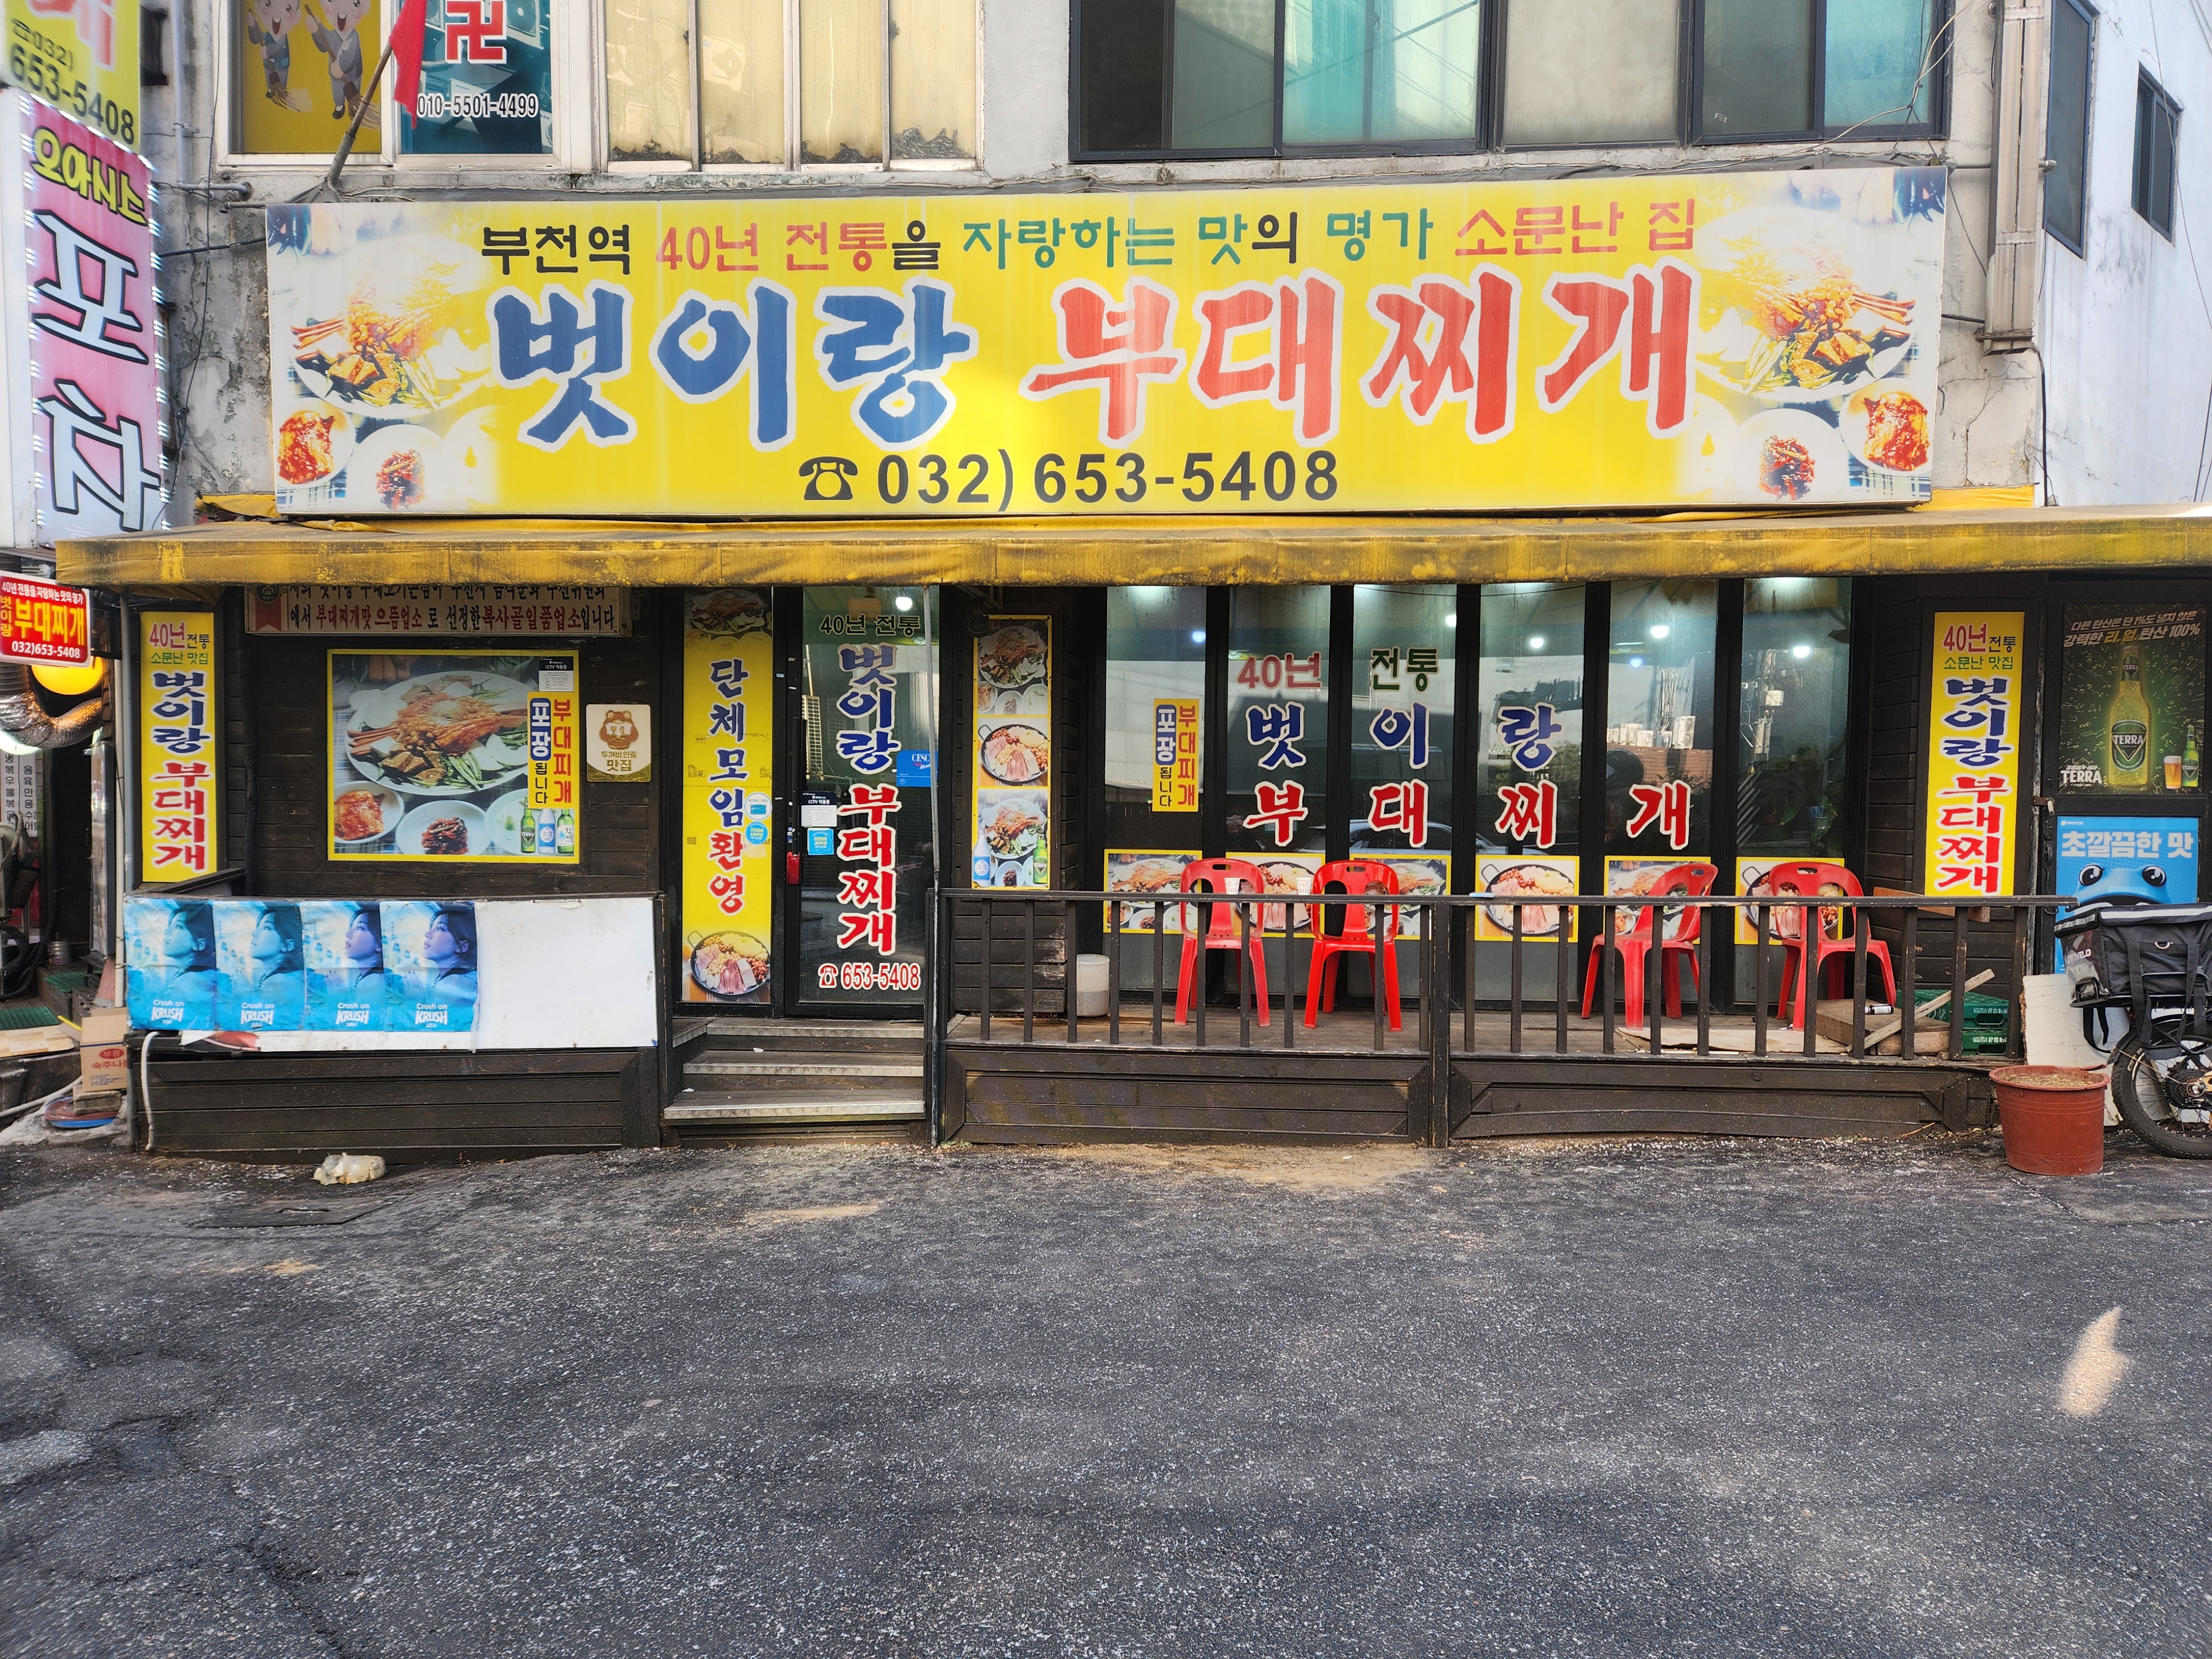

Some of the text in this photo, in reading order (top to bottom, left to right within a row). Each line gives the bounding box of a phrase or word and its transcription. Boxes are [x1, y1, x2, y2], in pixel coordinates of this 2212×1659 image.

[9, 42, 135, 145] 653-5408
[417, 93, 539, 117] 010-5501-4499
[31, 126, 149, 226] 오아시스
[481, 198, 1695, 275] 부천역 40년 전통을 자랑하는 맛의 명가 소문난 집
[493, 264, 1694, 444] 벗이랑 부대찌개
[877, 448, 1338, 512] 032) 653-5408
[2, 581, 84, 605] 40년 전통을 자랑하는 맛의 명가
[0, 595, 13, 637] 벗이랑
[14, 598, 85, 646] 부대찌개
[819, 614, 921, 637] 40년 전통
[2070, 620, 2092, 631] 다른
[2092, 617, 2122, 629] 탄산은
[149, 622, 210, 649] 40년 전통
[1943, 623, 2016, 653] 40년 전통
[2063, 631, 2104, 648] 강력한
[2168, 622, 2201, 638] 100%
[11, 640, 81, 659] 032)653-5408
[150, 651, 208, 665] 소문난 맛집
[1237, 646, 1439, 692] 40년 전통
[1944, 656, 2013, 670] 소문난 맛집
[152, 671, 211, 754] 벗이랑
[838, 644, 900, 771] 벗이랑
[1943, 677, 2012, 766] 벗이랑
[2112, 734, 2145, 745] TERRA
[606, 759, 632, 772] 맛집
[911, 753, 930, 763] CESC
[2060, 770, 2103, 784] TERRA
[153, 762, 211, 871] 부대찌개
[1937, 776, 2009, 893] 부대찌개
[2061, 830, 2194, 858] 초깔끔한 맛
[838, 784, 900, 953] 부대찌개
[842, 963, 921, 989] 653-5408
[150, 1006, 184, 1022] KRUSH
[240, 1010, 274, 1025] KRUSH
[335, 1010, 369, 1024] KRUSH
[415, 1010, 448, 1025] KRUSH
